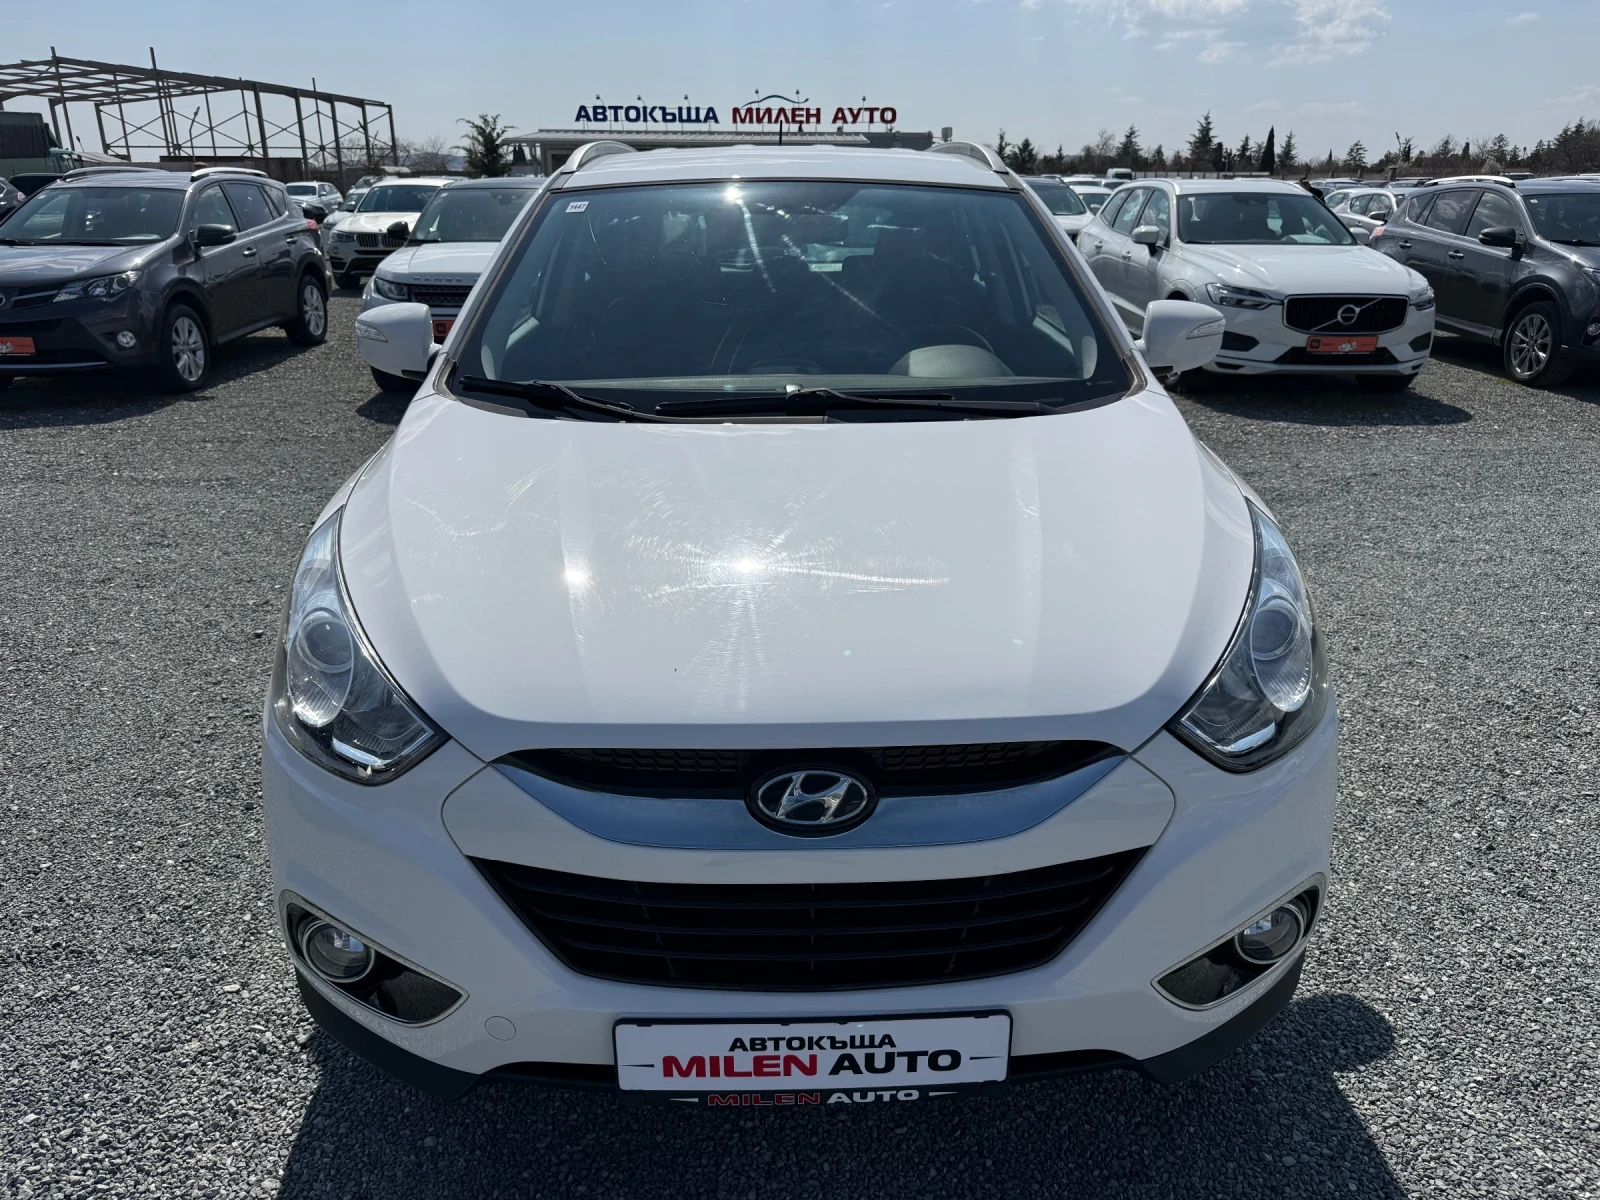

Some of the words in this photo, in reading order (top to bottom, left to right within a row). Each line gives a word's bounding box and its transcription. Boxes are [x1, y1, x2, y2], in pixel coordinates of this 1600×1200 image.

[732, 107, 821, 125] МИЛЕН
[831, 107, 897, 125] АУТО
[662, 1054, 818, 1078] MILEN
[828, 1049, 962, 1075] AUTO
[707, 1093, 821, 1106] MILEN
[826, 1089, 920, 1104] AUTO
